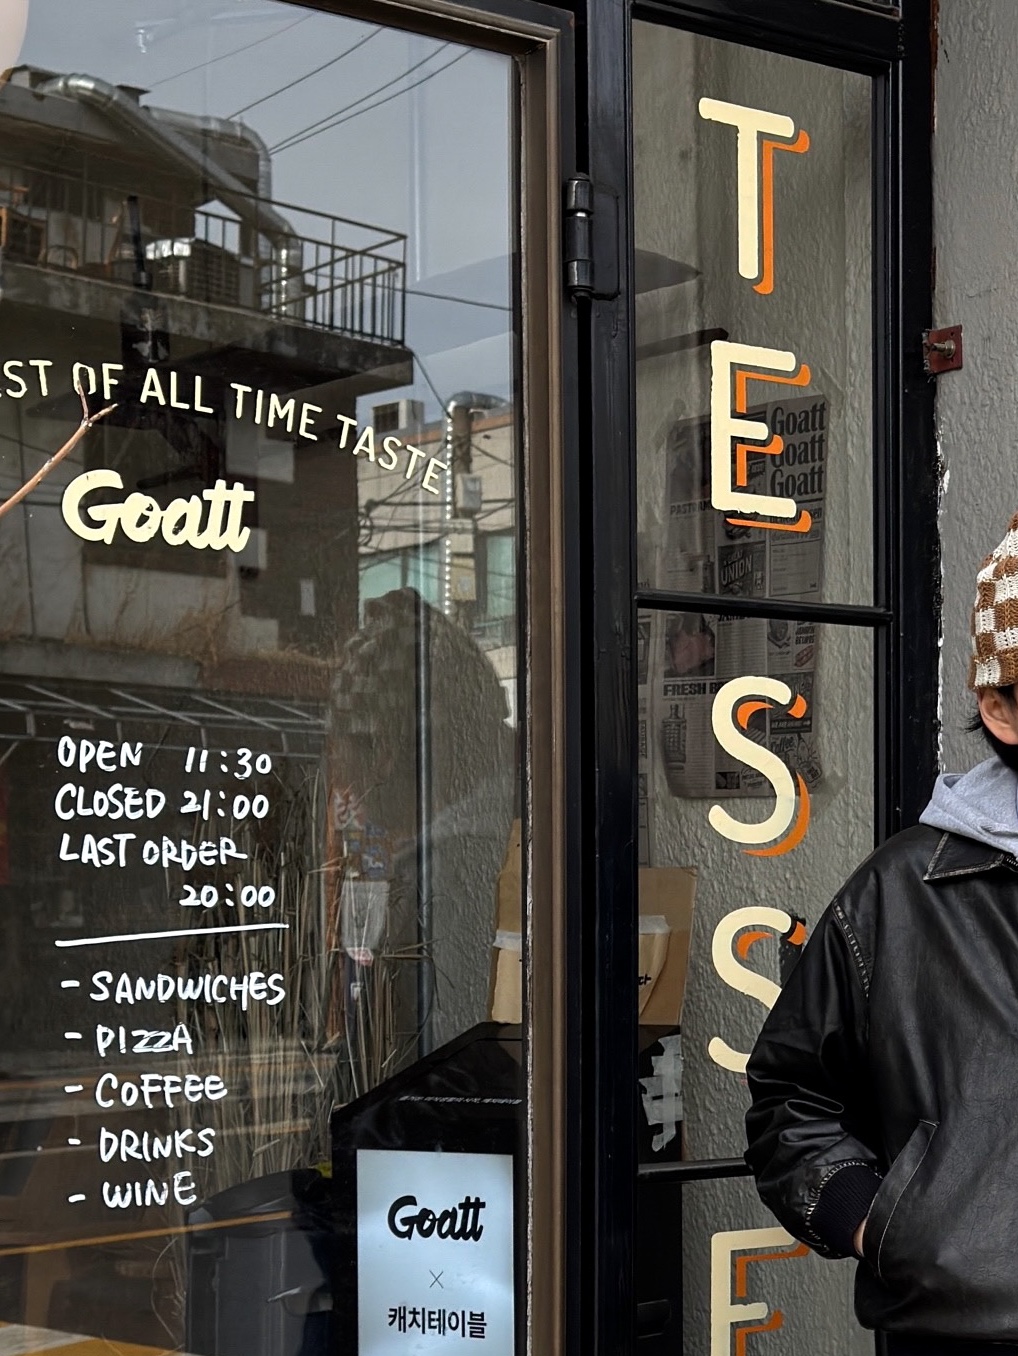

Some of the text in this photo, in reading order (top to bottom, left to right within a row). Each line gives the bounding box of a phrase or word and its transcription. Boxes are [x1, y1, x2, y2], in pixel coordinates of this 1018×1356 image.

[0, 360, 448, 495] ST OF ALL TIME TASTE
[771, 402, 826, 436] Goatt
[770, 465, 825, 498] Goatt
[62, 470, 254, 552] Goatt
[720, 554, 752, 586] UNION
[663, 681, 707, 696] FRESH
[58, 736, 272, 779] OPEN 11:30
[55, 783, 269, 820] CLOSED 21:00
[60, 834, 247, 870] LAST ORDER
[180, 883, 276, 907] 20:00
[90, 971, 286, 1010] SANDWICHES
[97, 1024, 193, 1056] PIZZA
[96, 1073, 228, 1108] COFFEE
[100, 1127, 215, 1162] DRINKS
[103, 1171, 197, 1208] WINE
[388, 1196, 486, 1241] Goatt
[388, 1306, 488, 1339] 캐치테이블
